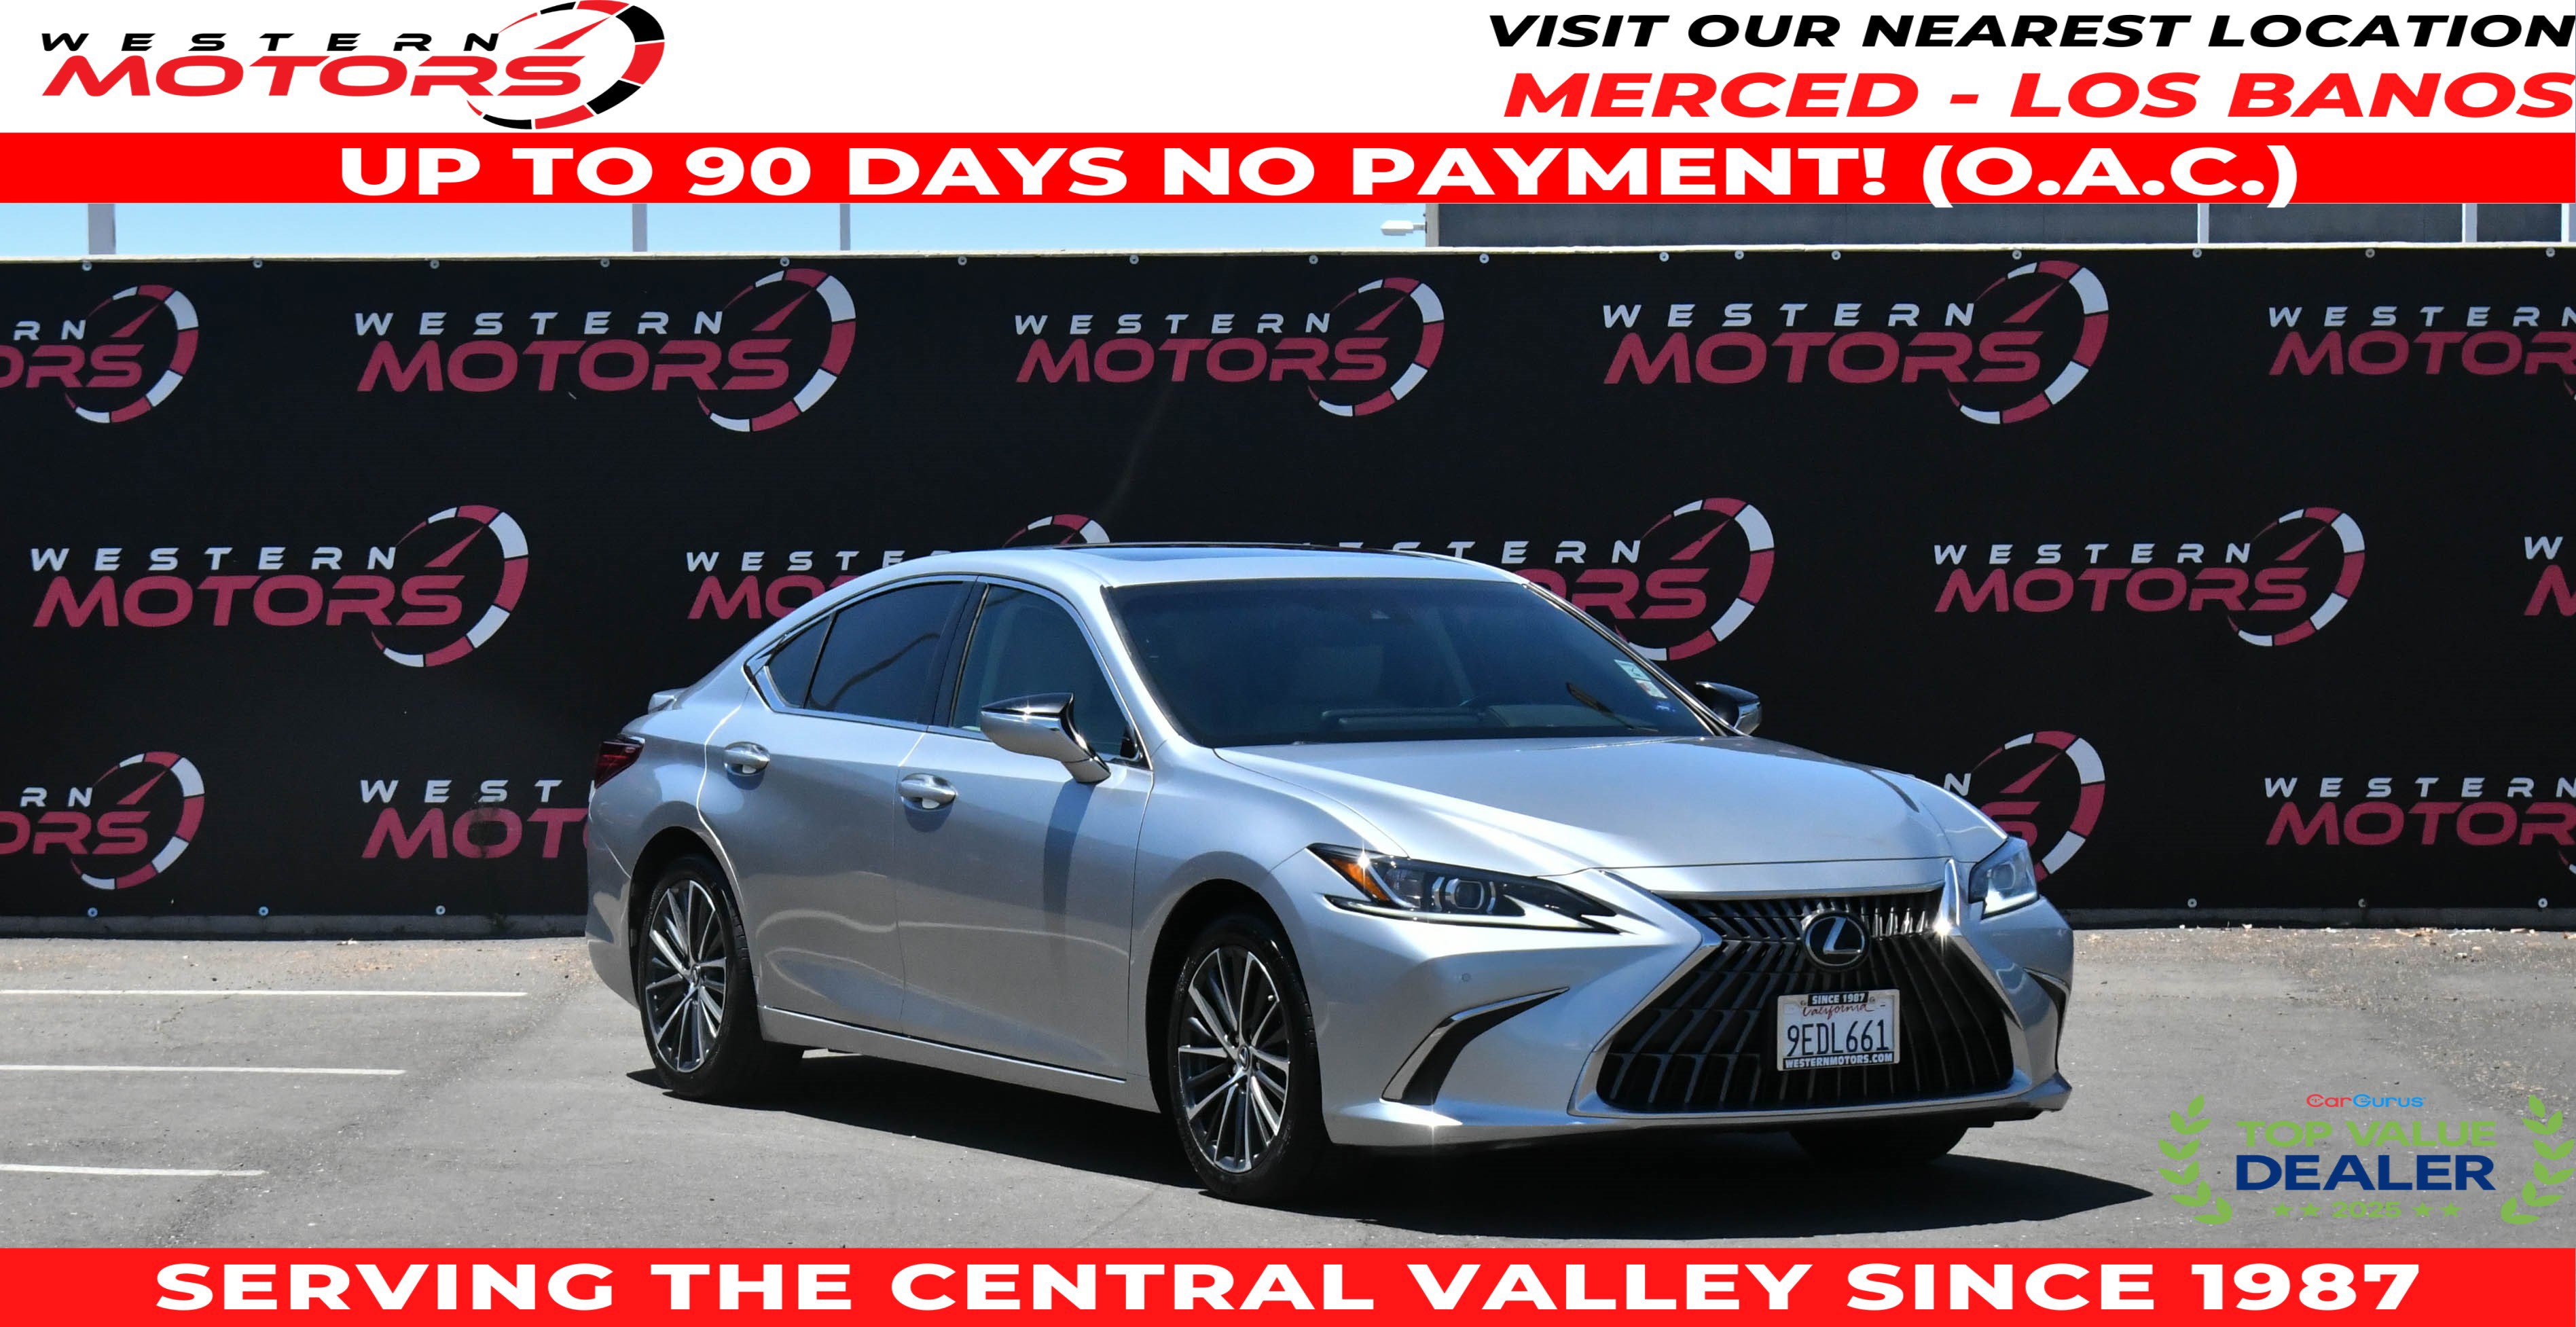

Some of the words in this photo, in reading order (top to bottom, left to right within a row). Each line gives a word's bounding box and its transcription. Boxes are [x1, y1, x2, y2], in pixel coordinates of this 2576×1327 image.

[355, 311, 723, 336] WESTERN
[1015, 312, 1330, 335] WESTERN
[1603, 303, 1974, 328] WESTERN
[1017, 338, 1387, 383] MOTORS
[1605, 331, 2042, 384] MOTORS
[2269, 331, 2576, 375] MOTOR
[357, 340, 792, 392] MOTORS
[31, 546, 396, 571] WESTERN
[1934, 543, 2251, 565] WESTERN
[33, 575, 464, 628] MOTORS
[1935, 568, 2308, 613] MOTORS
[2264, 778, 2576, 798] WESTERN
[2266, 801, 2576, 846] MOTOR
[1802, 1002, 1875, 1020] California
[1811, 994, 1840, 1005] SINCE
[1842, 992, 1866, 1004] 1987
[1786, 1019, 1889, 1057] 9EDL661
[1785, 1053, 1893, 1069] WESTERNMOTORS.COM
